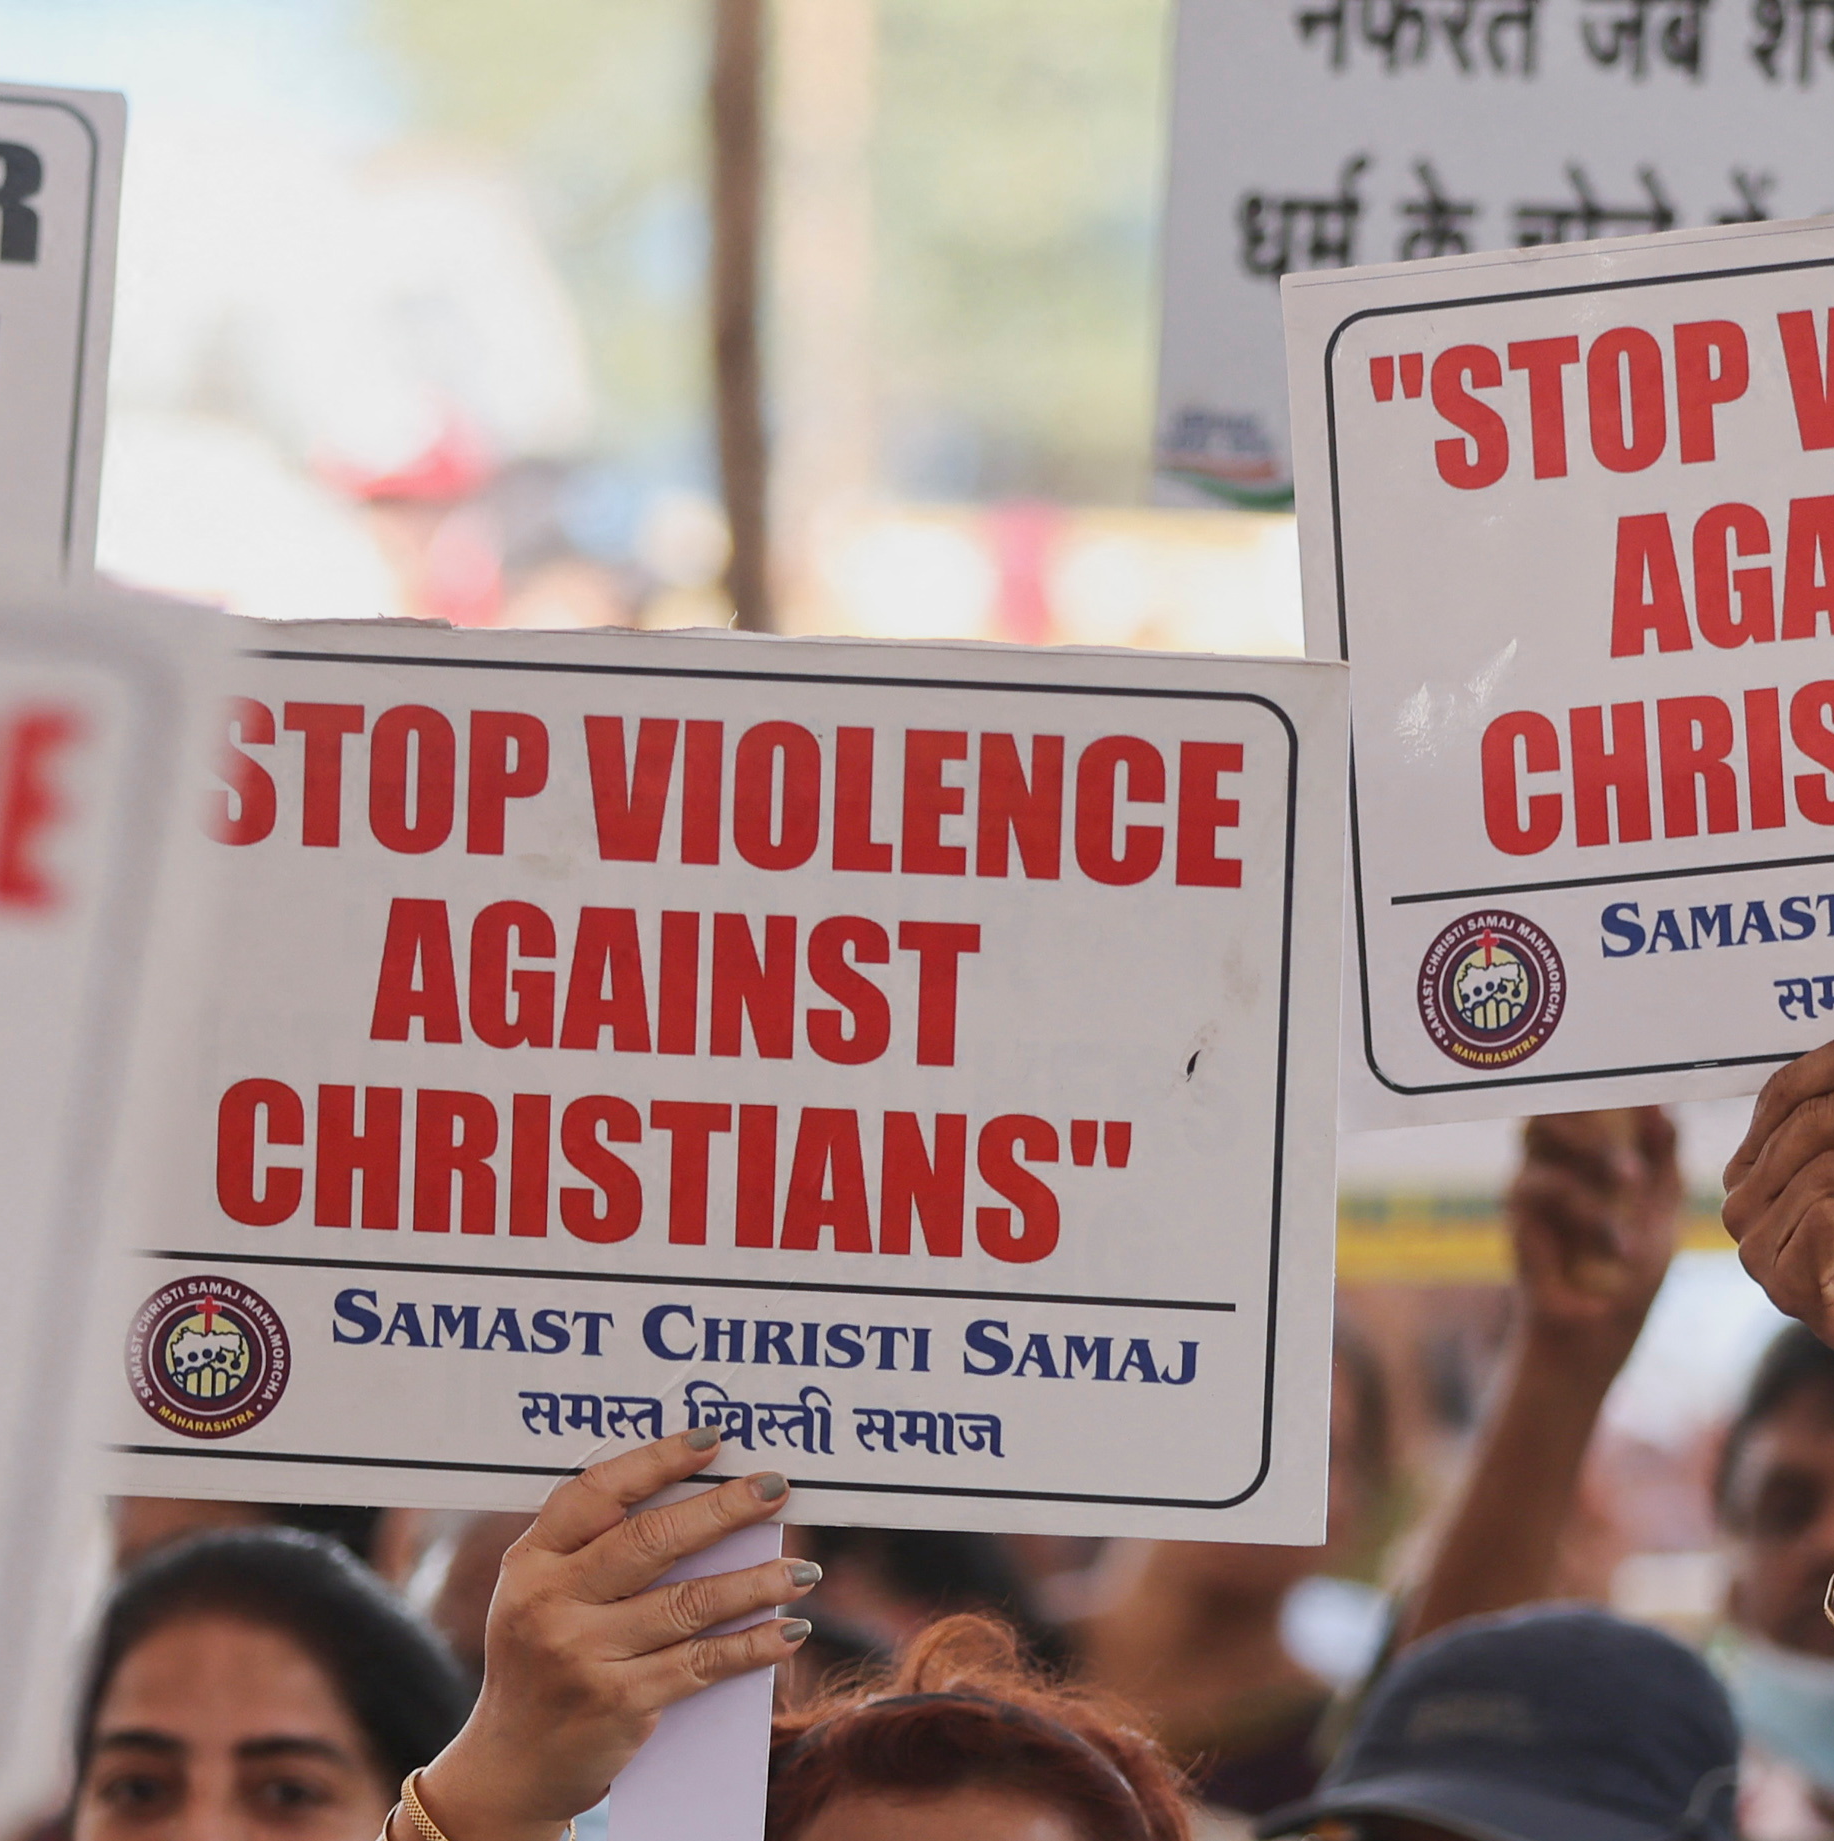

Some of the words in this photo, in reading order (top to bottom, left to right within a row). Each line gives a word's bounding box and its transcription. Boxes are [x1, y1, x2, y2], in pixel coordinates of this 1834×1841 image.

[1370, 320, 1750, 492] "STOP
[583, 715, 1244, 888] VIOLENCE
[1425, 924, 1465, 976] CHRISTI
[1467, 915, 1515, 931] SAMAJ
[369, 897, 982, 1067] AGAINST
[1517, 923, 1561, 1024] MAHAMORCHA
[1422, 979, 1446, 1039] SAMAST
[1451, 1035, 1539, 1064] MAHARASHTRA
[215, 1078, 1133, 1265] CHRISTIANS"
[136, 1287, 184, 1333] CHRISTI
[188, 1282, 241, 1299] SAMAJ
[130, 1335, 154, 1399] SAMAST
[242, 1294, 284, 1401] MAHAMORCHA
[332, 1287, 614, 1358] SAMAST
[642, 1303, 931, 1372] CHRISTI
[963, 1318, 1201, 1386] SAMAJ
[157, 1405, 255, 1432] MAHARASHTRA
[518, 1389, 665, 1439] समस्त
[853, 1406, 1005, 1458] समाज
